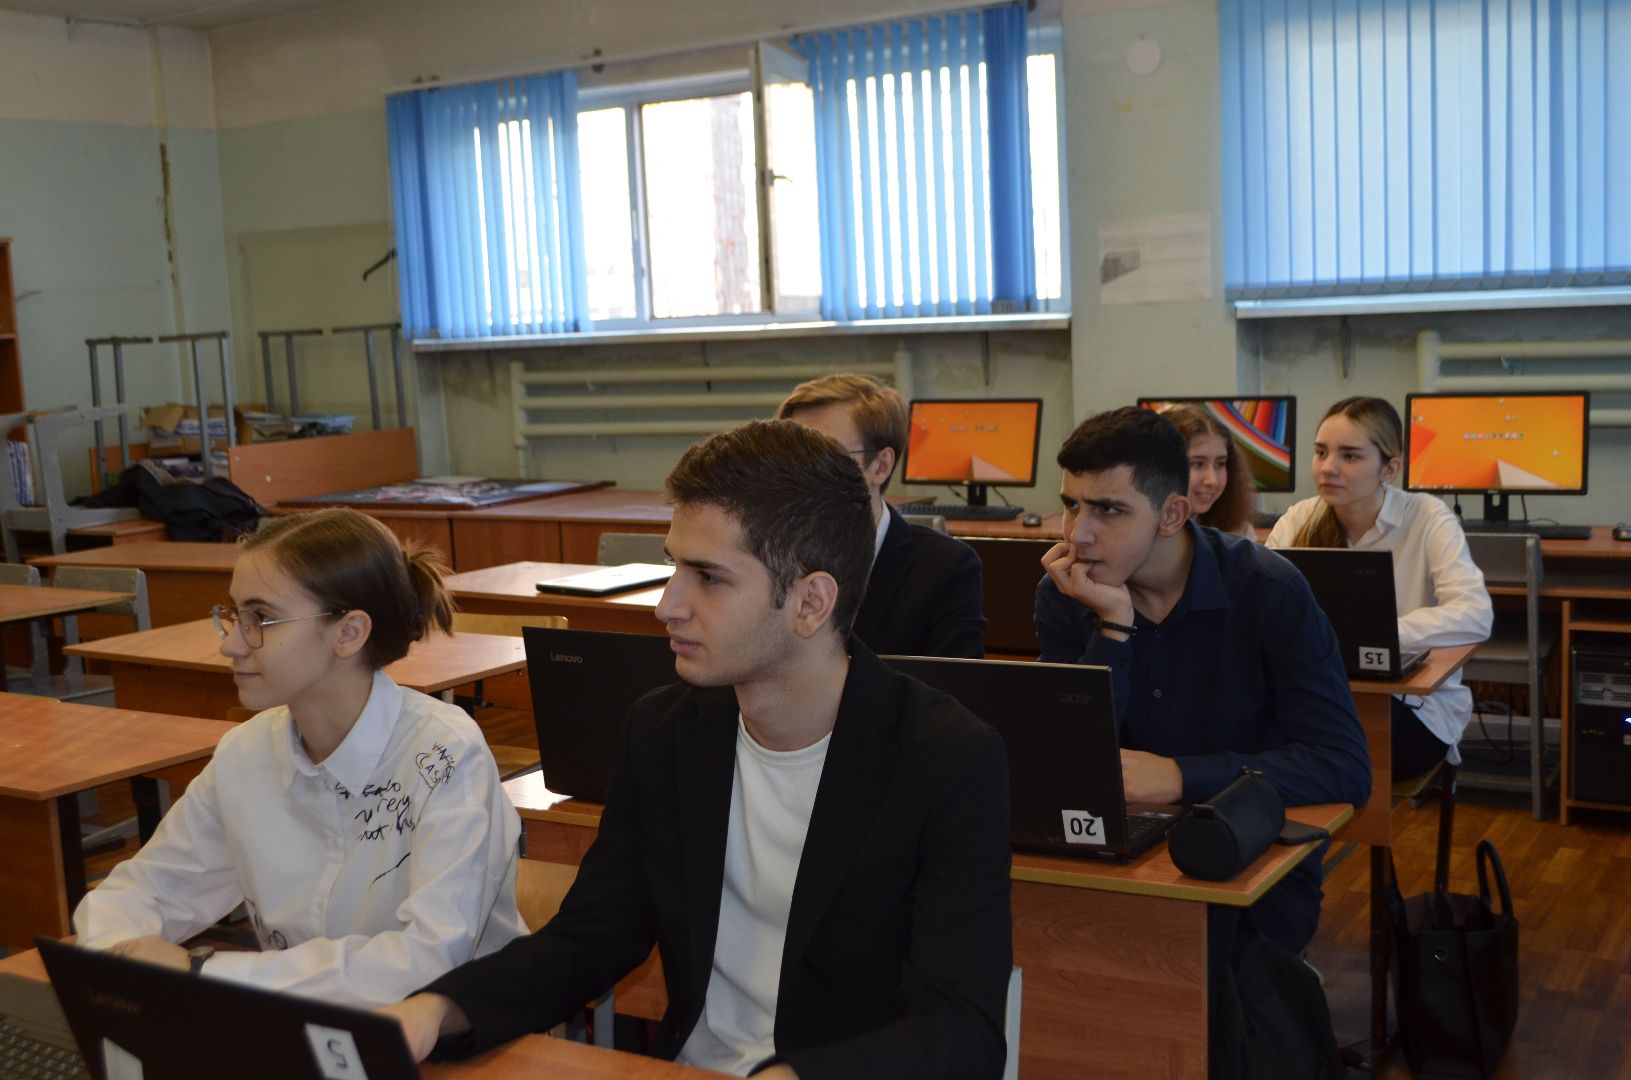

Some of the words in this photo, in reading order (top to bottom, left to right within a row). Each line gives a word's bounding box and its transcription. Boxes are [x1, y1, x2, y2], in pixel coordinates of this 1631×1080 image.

[550, 651, 584, 664] Lenovo
[1364, 652, 1384, 665] 15
[1070, 817, 1097, 836] 20
[327, 1038, 349, 1070] 5
